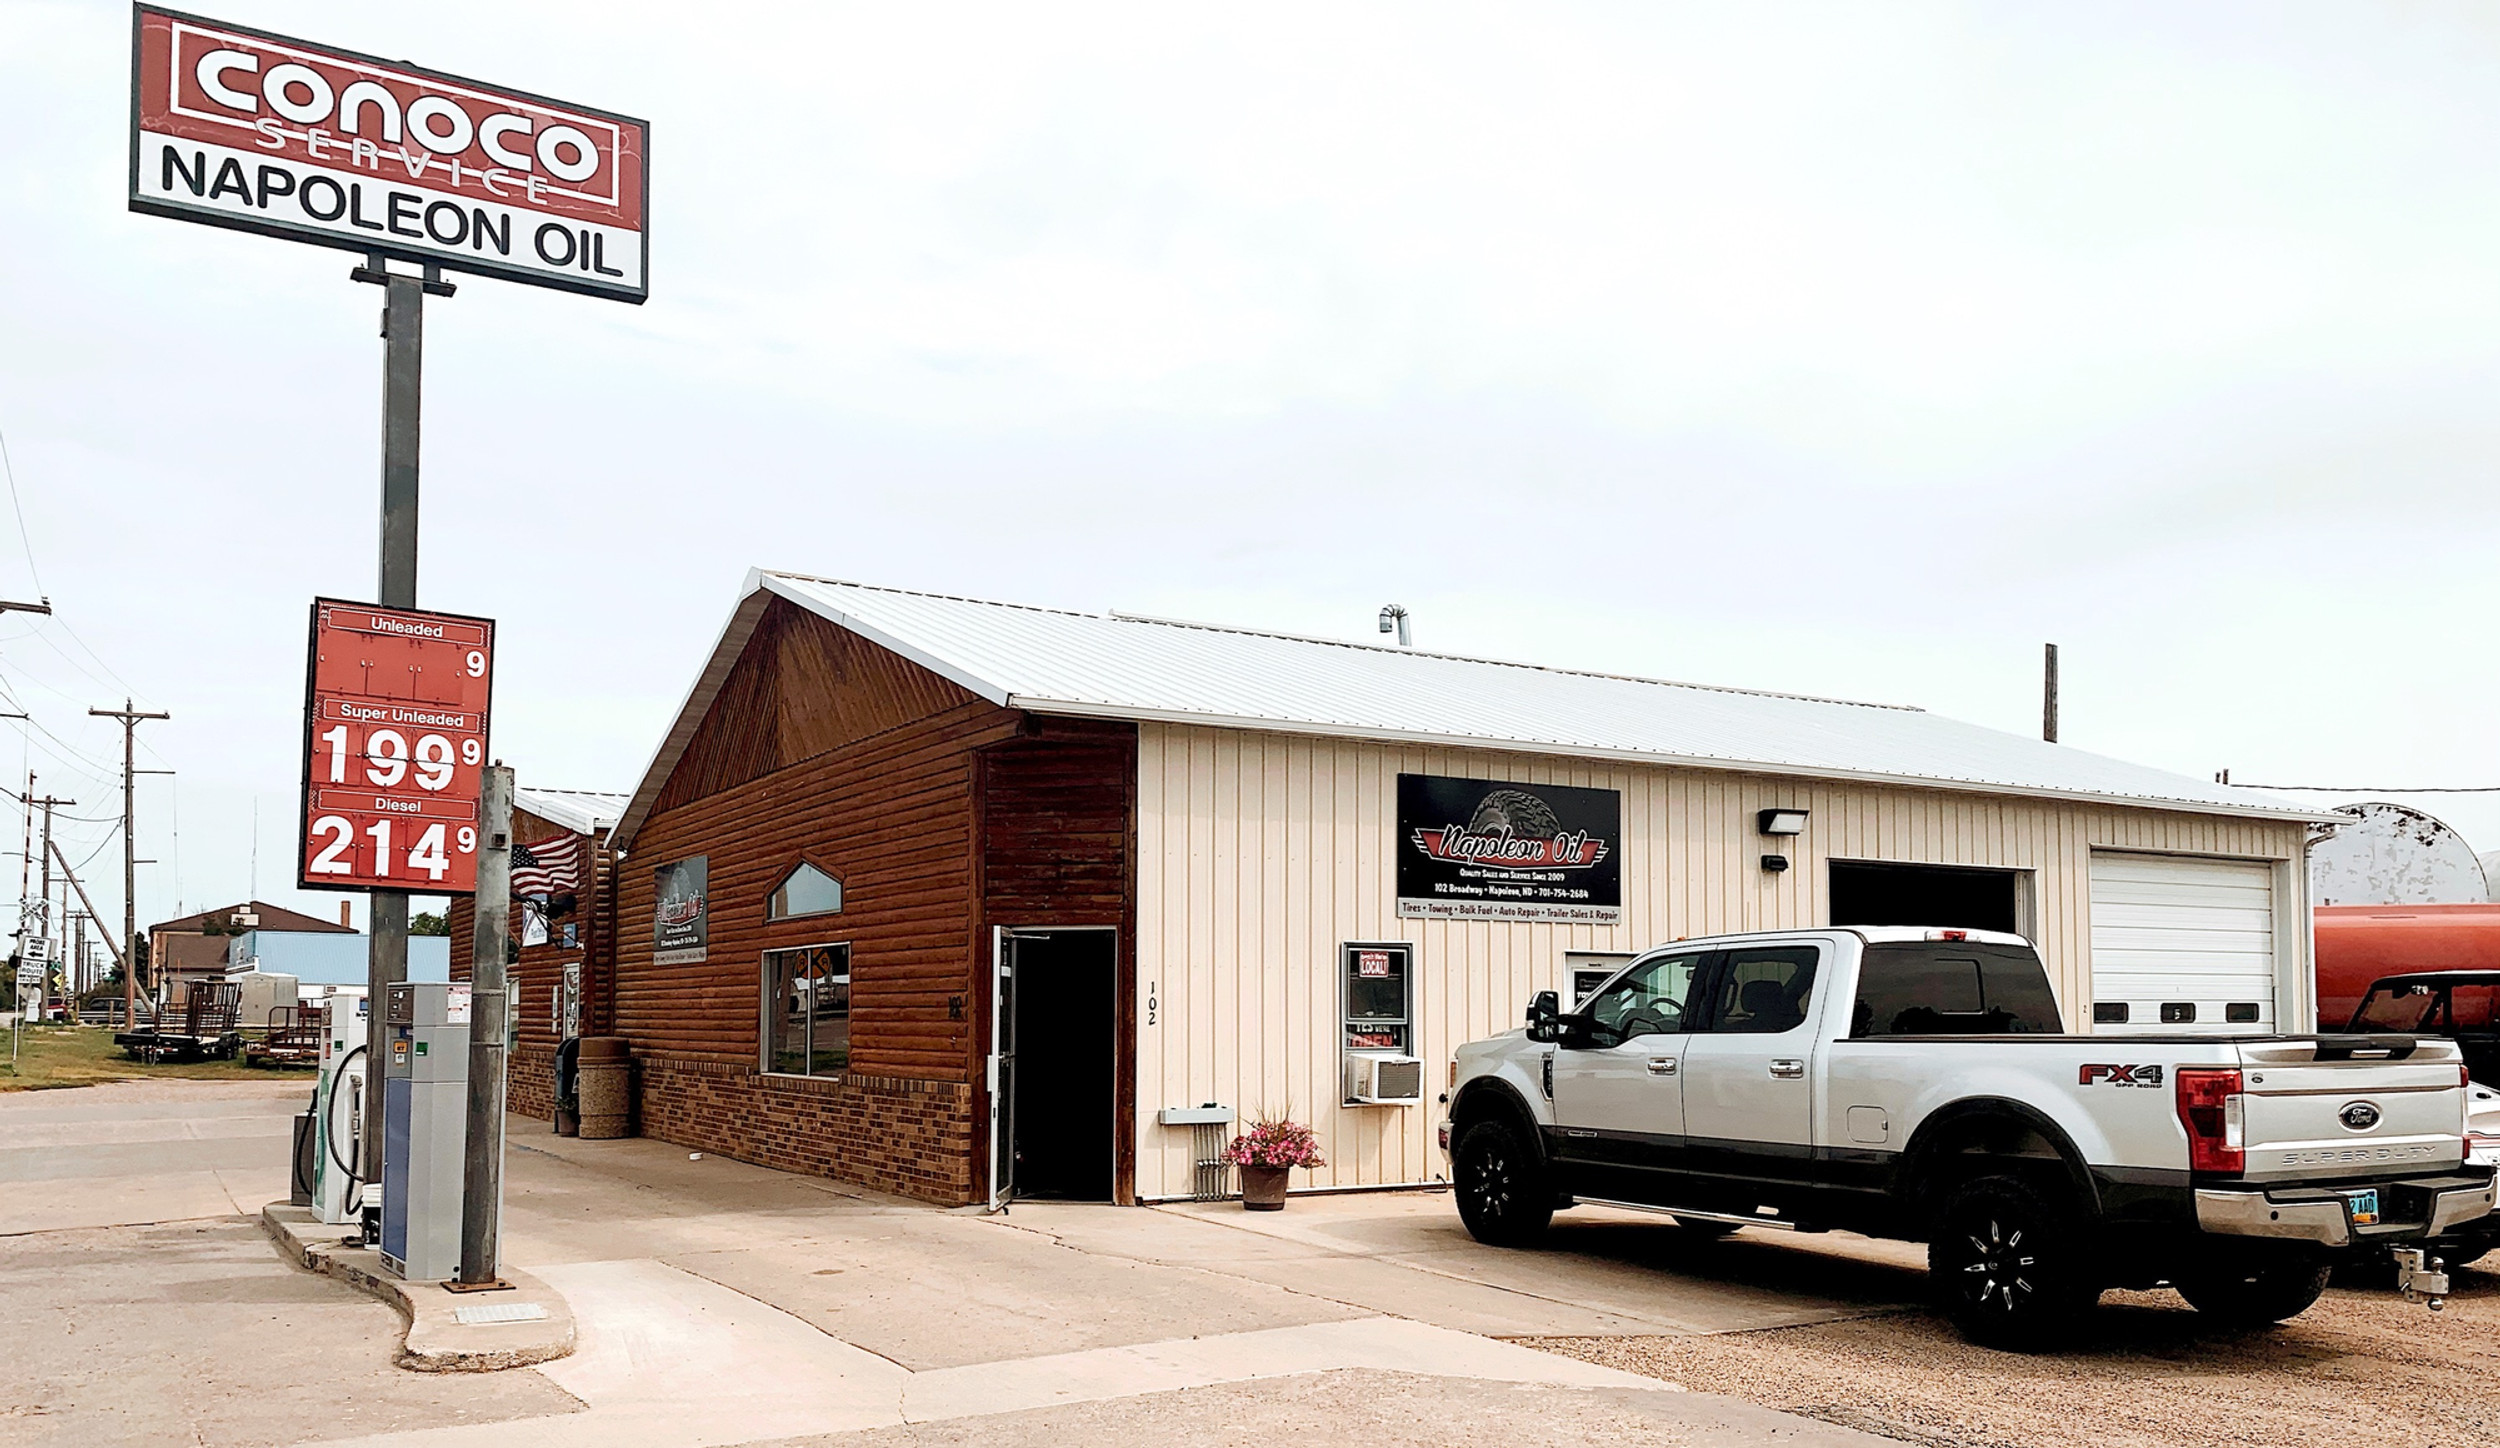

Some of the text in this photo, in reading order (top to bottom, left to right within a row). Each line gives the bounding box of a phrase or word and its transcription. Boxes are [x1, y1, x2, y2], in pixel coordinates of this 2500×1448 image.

[253, 117, 549, 205] SERVICE
[162, 145, 623, 278] NAPOLEON OIL
[371, 616, 443, 638] Unleaded
[466, 650, 485, 677] 9
[340, 704, 464, 727] Super Unleaded
[322, 725, 455, 792] 199
[375, 797, 421, 812] Diesel
[310, 815, 449, 880] 214
[1438, 824, 1587, 865] Napoleon Oil
[1548, 872, 1565, 881] 2009
[1434, 883, 1589, 899] 102 Broadway Napoleon, ND 701-754-2684
[1402, 902, 1421, 912] Tires
[1428, 903, 1453, 916] Towing
[1459, 904, 1476, 914] Bulk
[1478, 905, 1493, 915] Fuel
[1499, 906, 1516, 916] Auto
[1518, 907, 1540, 918] Repair
[1547, 908, 1569, 918] Trailer
[1570, 908, 1588, 919] Sales
[1596, 910, 1618, 921] Repair
[1148, 981, 1157, 1026] 102
[2079, 1064, 2163, 1085] FX4
[2350, 1108, 2372, 1124] Ford
[2282, 1146, 2436, 1165] SUPER DUTY
